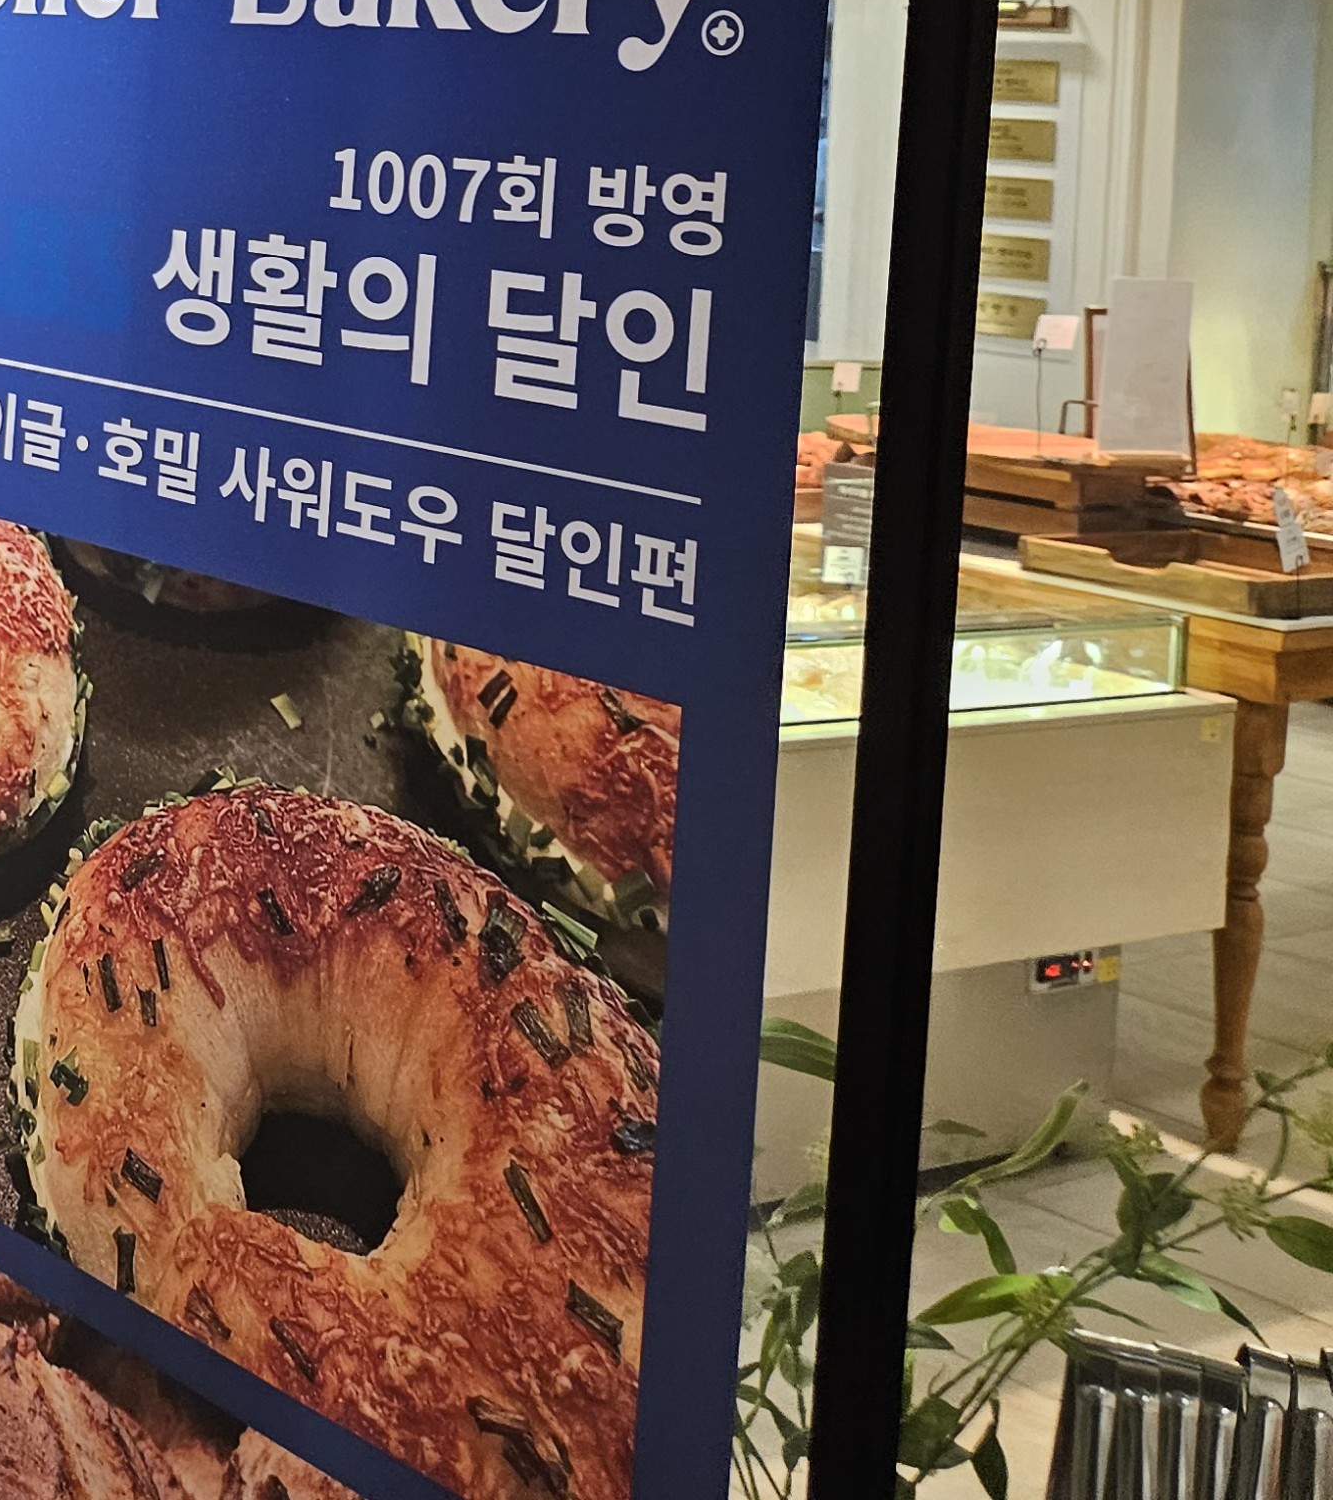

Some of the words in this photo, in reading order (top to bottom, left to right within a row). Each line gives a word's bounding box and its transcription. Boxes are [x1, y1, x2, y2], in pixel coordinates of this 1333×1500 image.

[330, 147, 557, 239] 1007회
[588, 164, 729, 258] 방영
[152, 227, 438, 386] 생활의
[488, 269, 713, 432] 달인
[219, 446, 463, 565] 사워도우
[491, 500, 698, 627] 달인편
